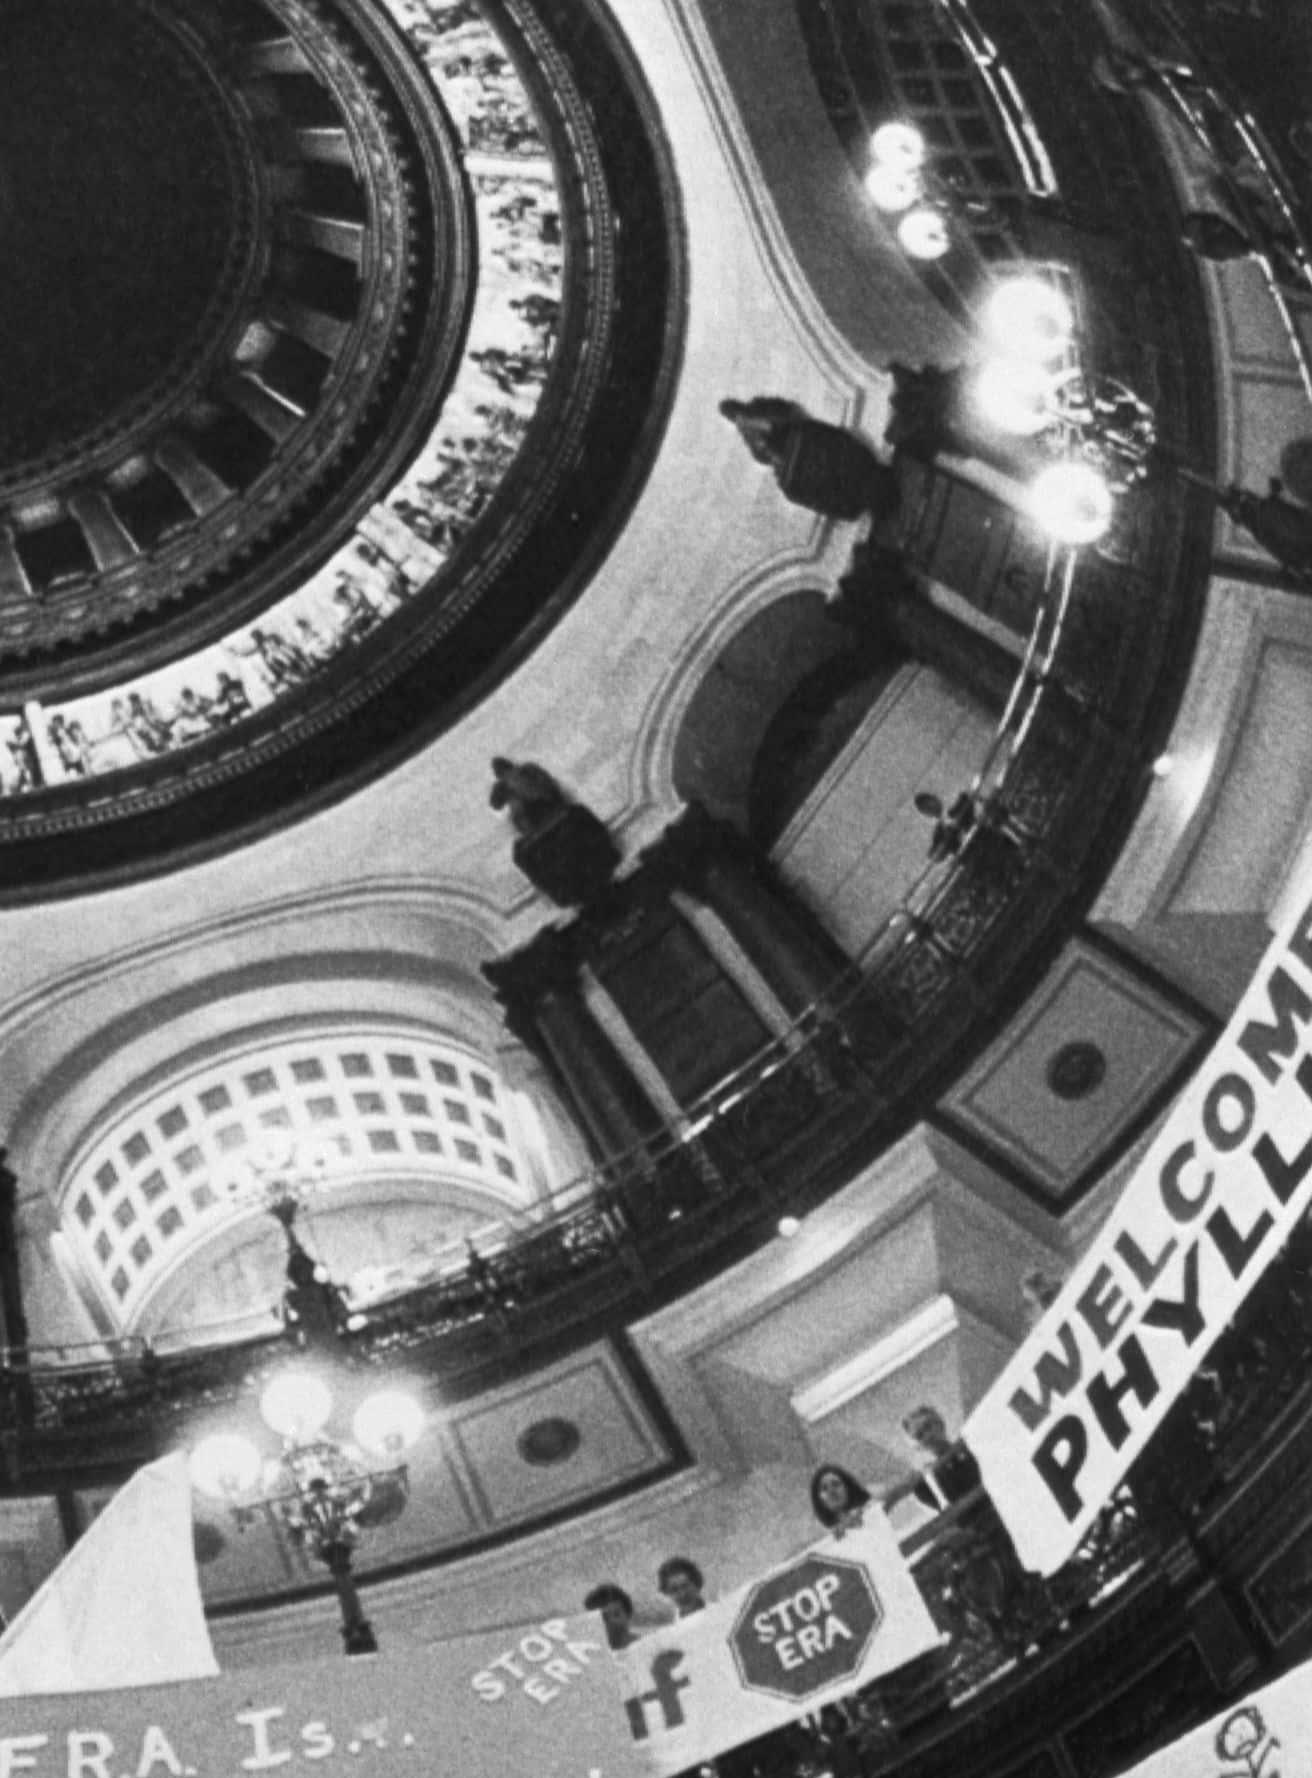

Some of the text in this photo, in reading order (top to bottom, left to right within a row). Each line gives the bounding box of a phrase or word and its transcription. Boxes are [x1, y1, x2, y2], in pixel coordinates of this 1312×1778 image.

[1008, 904, 1312, 1432] WELCOM
[1032, 1053, 1312, 1523] PHYLL
[753, 1573, 840, 1643] STOP
[774, 1616, 852, 1671] ERA
[471, 1618, 571, 1702] STOP
[524, 1633, 601, 1704] ERA
